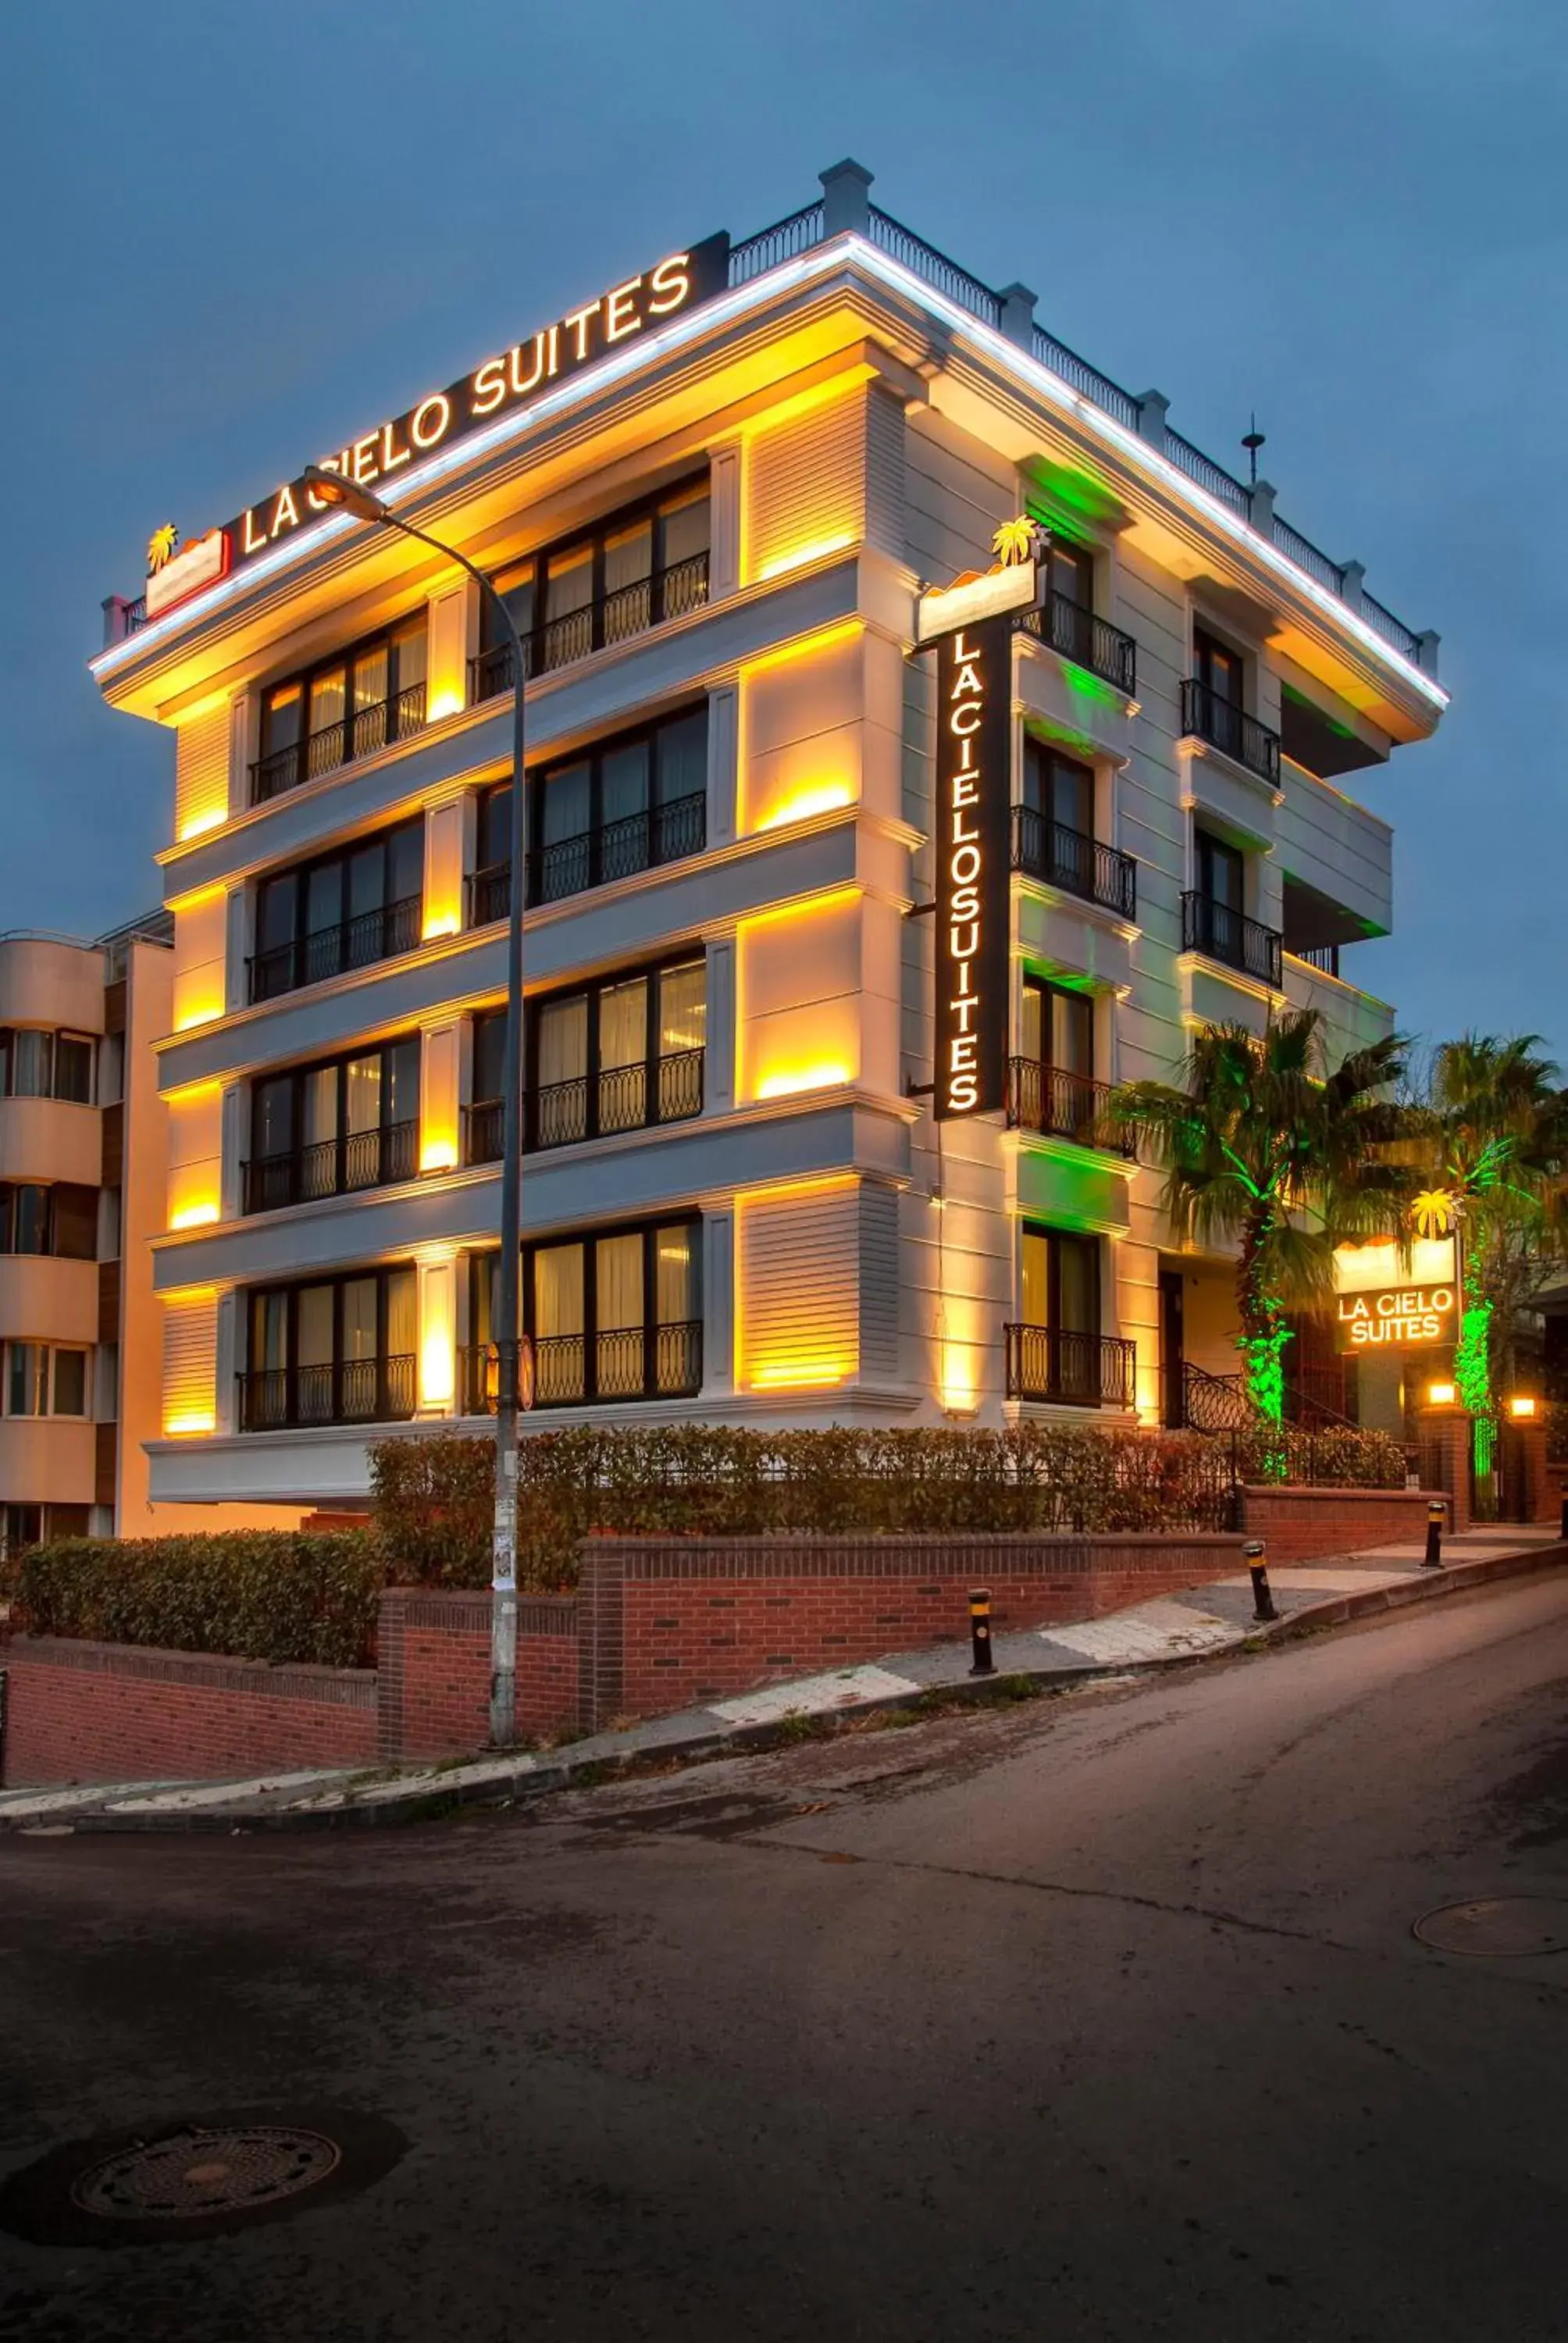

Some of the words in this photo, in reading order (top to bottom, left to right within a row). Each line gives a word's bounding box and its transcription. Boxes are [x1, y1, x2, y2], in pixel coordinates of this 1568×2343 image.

[244, 486, 300, 554] LA
[472, 255, 690, 414] SUITES
[1338, 1298, 1369, 1321] LA
[1377, 1289, 1452, 1317] CIELO
[1351, 1315, 1440, 1343] SUITES
